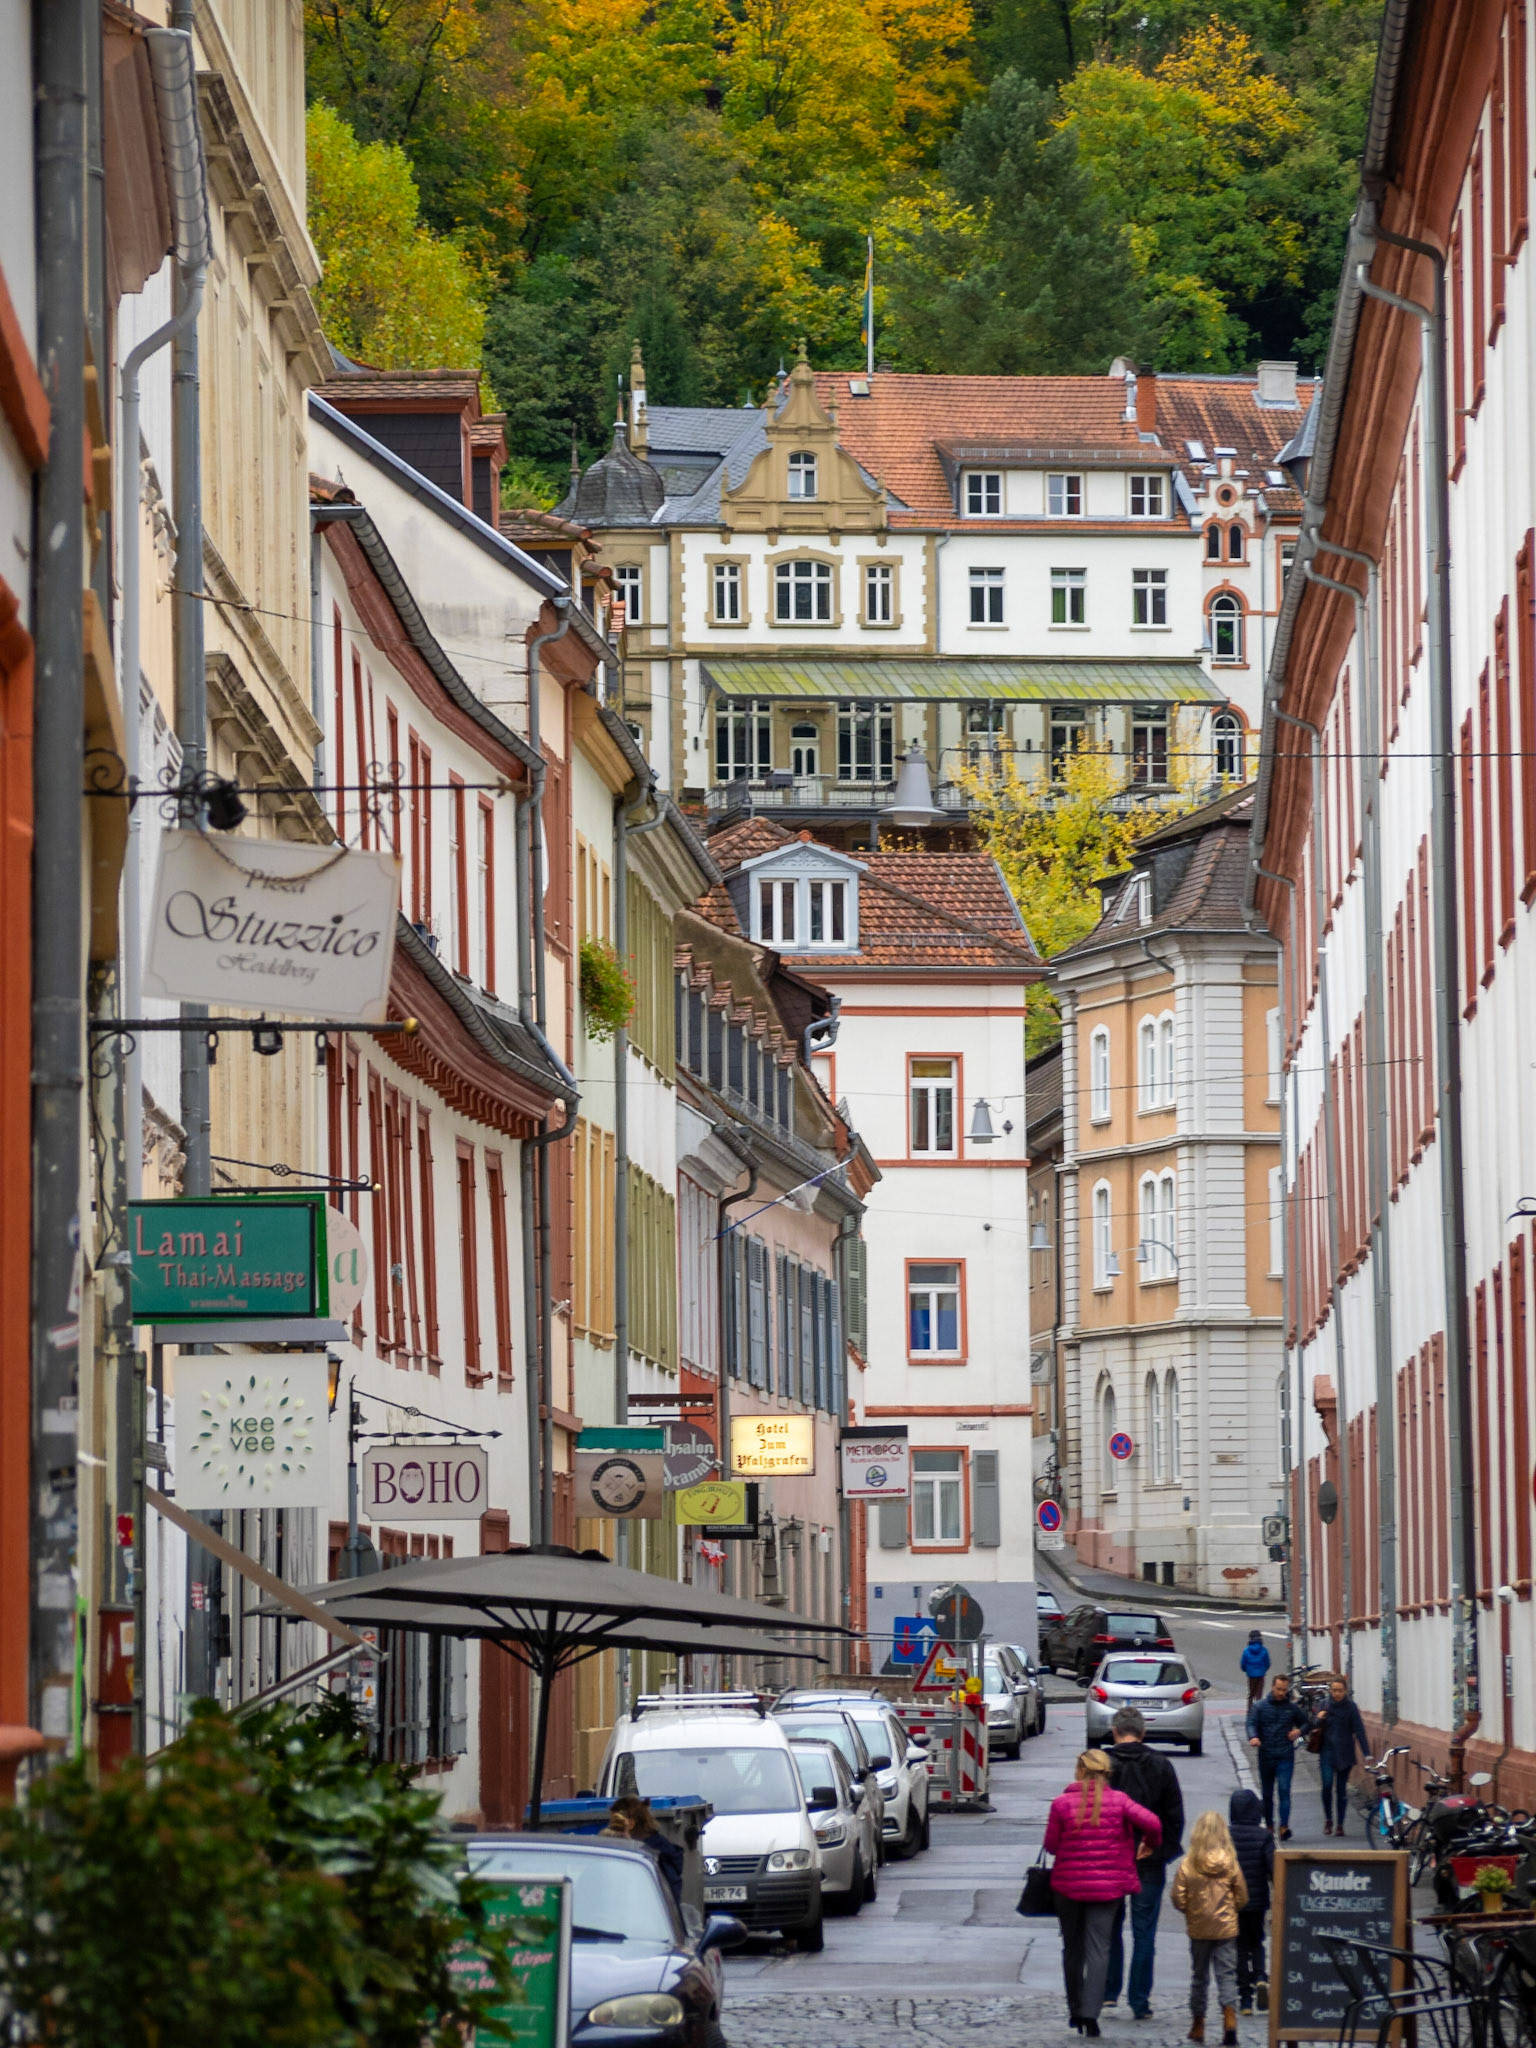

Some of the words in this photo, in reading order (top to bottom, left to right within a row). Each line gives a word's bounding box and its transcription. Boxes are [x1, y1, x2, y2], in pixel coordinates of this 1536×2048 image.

[166, 890, 380, 957] Stuzzico
[136, 1215, 242, 1257] Lamai
[159, 1262, 307, 1292] Thai-Massage
[756, 1423, 789, 1436] Hotel
[372, 1461, 480, 1504] BOHO
[1309, 1870, 1371, 1893] Stauder
